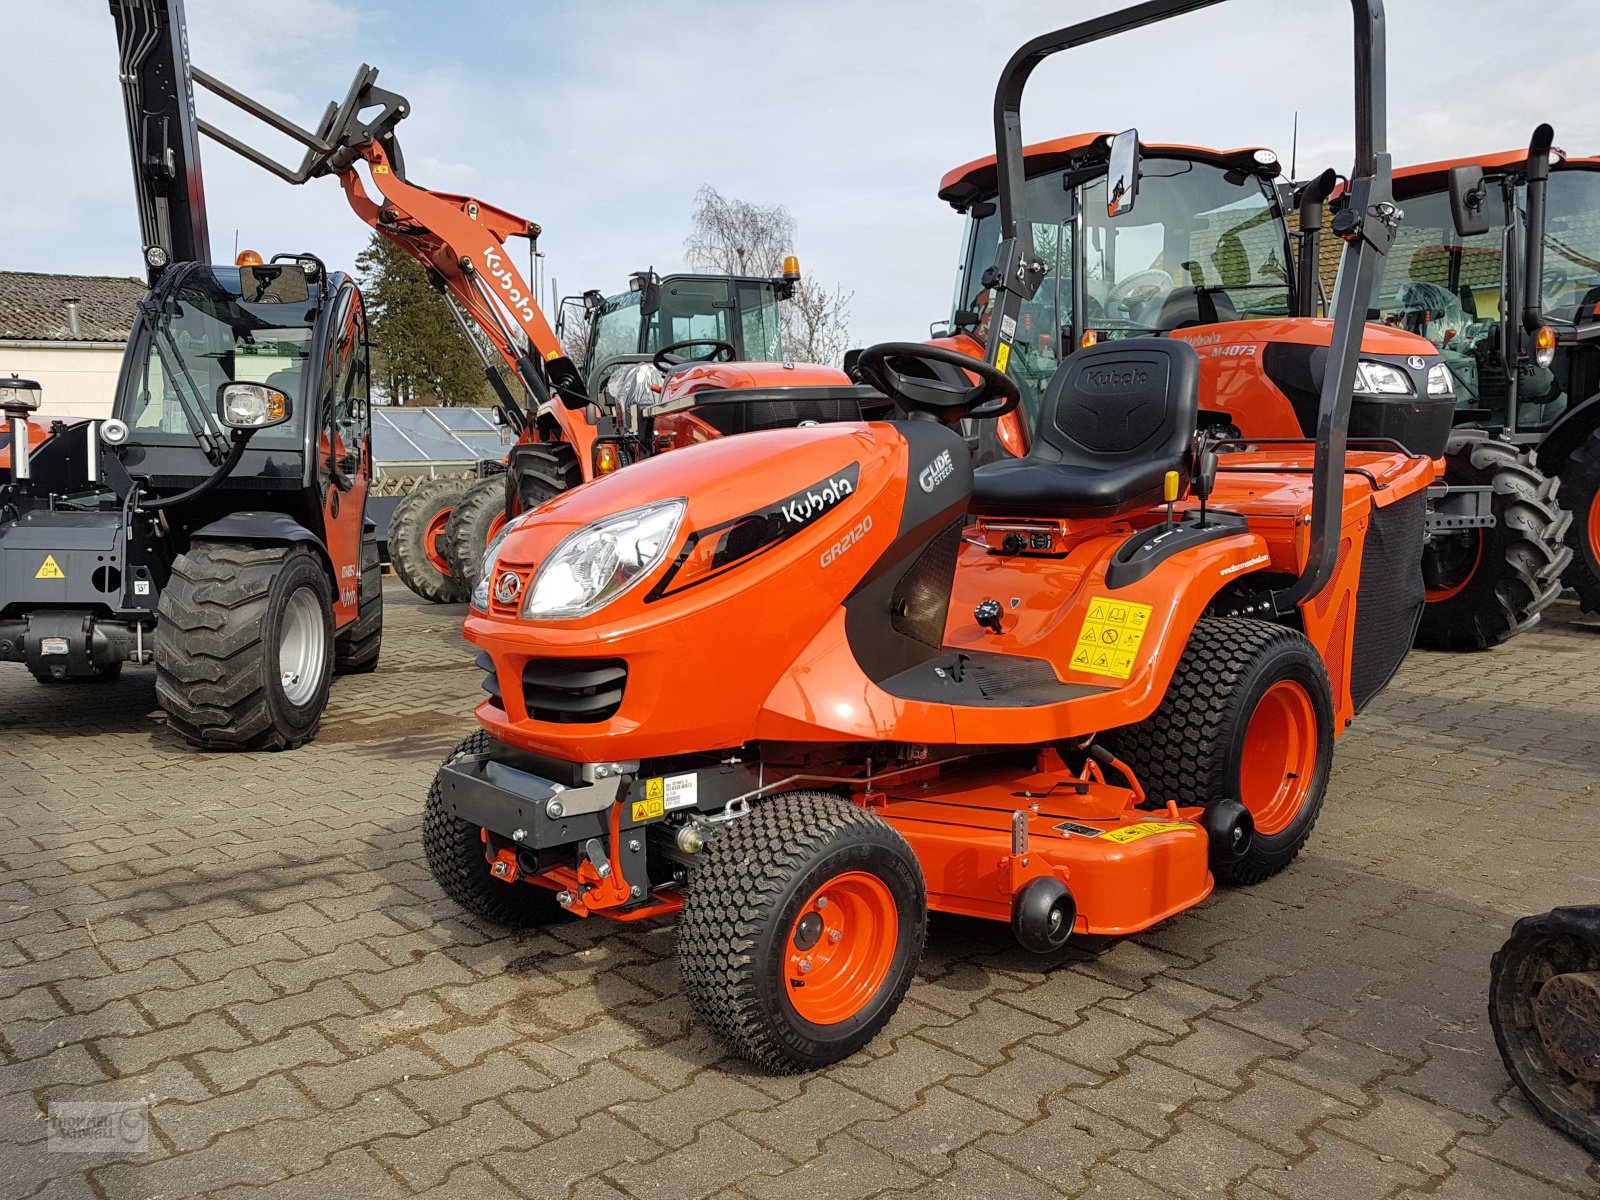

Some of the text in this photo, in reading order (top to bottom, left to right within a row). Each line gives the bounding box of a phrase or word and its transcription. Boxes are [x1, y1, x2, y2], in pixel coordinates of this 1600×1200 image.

[483, 246, 534, 322] Kubota
[1184, 331, 1221, 346] Kubota
[1211, 345, 1257, 357] M4073
[1086, 368, 1148, 388] Kubota
[919, 449, 951, 492] GLIDE
[934, 463, 954, 485] STEER
[782, 478, 853, 523] Kubota
[820, 514, 873, 569] GR2120
